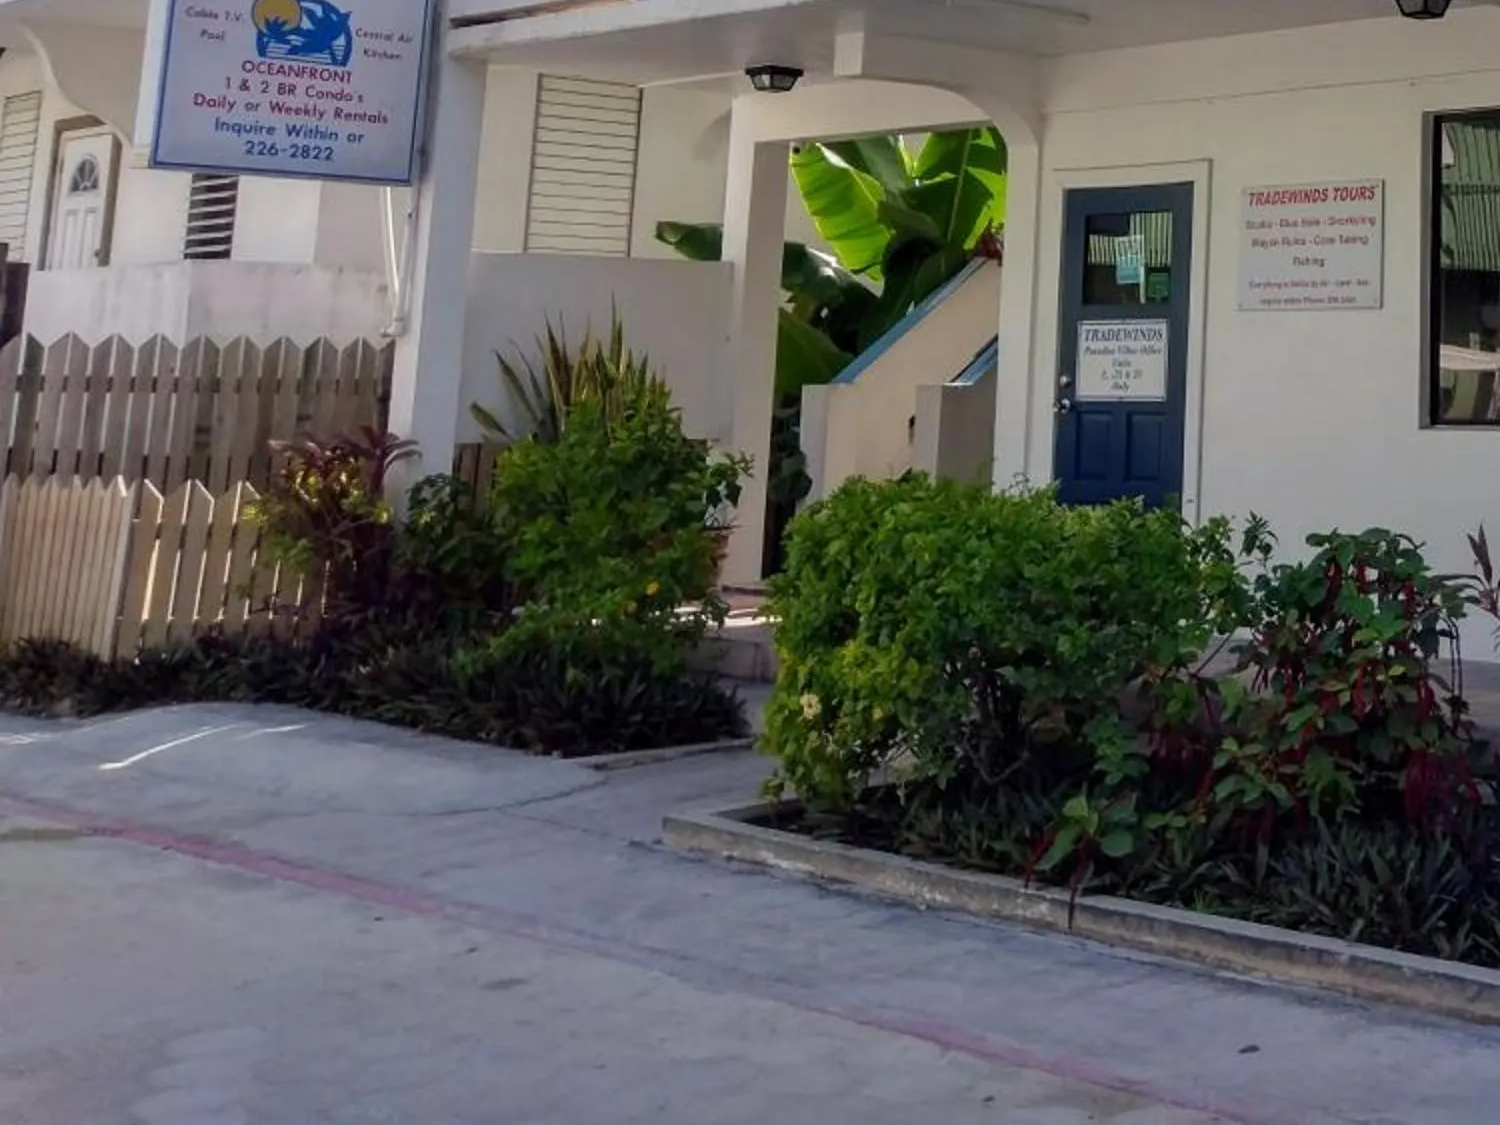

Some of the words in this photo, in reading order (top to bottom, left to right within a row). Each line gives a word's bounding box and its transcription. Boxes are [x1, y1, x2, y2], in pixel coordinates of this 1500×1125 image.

[200, 30, 225, 41] Pool
[242, 60, 352, 83] OCEANFRONT
[225, 77, 231, 89] 1
[239, 79, 251, 92] &
[260, 81, 269, 93] 2
[277, 83, 296, 97] BR
[193, 93, 236, 112] Daily
[244, 101, 261, 111] or
[269, 100, 325, 120] Weekly
[334, 106, 388, 124] Rentals
[214, 117, 276, 140] Inquire
[285, 124, 339, 142] Within
[347, 131, 365, 143] or
[244, 140, 334, 162] 226-2822
[1248, 188, 1329, 206] TRADEWINDS
[1333, 186, 1376, 201] TOURS
[1084, 328, 1163, 342] TRADEWINDS
